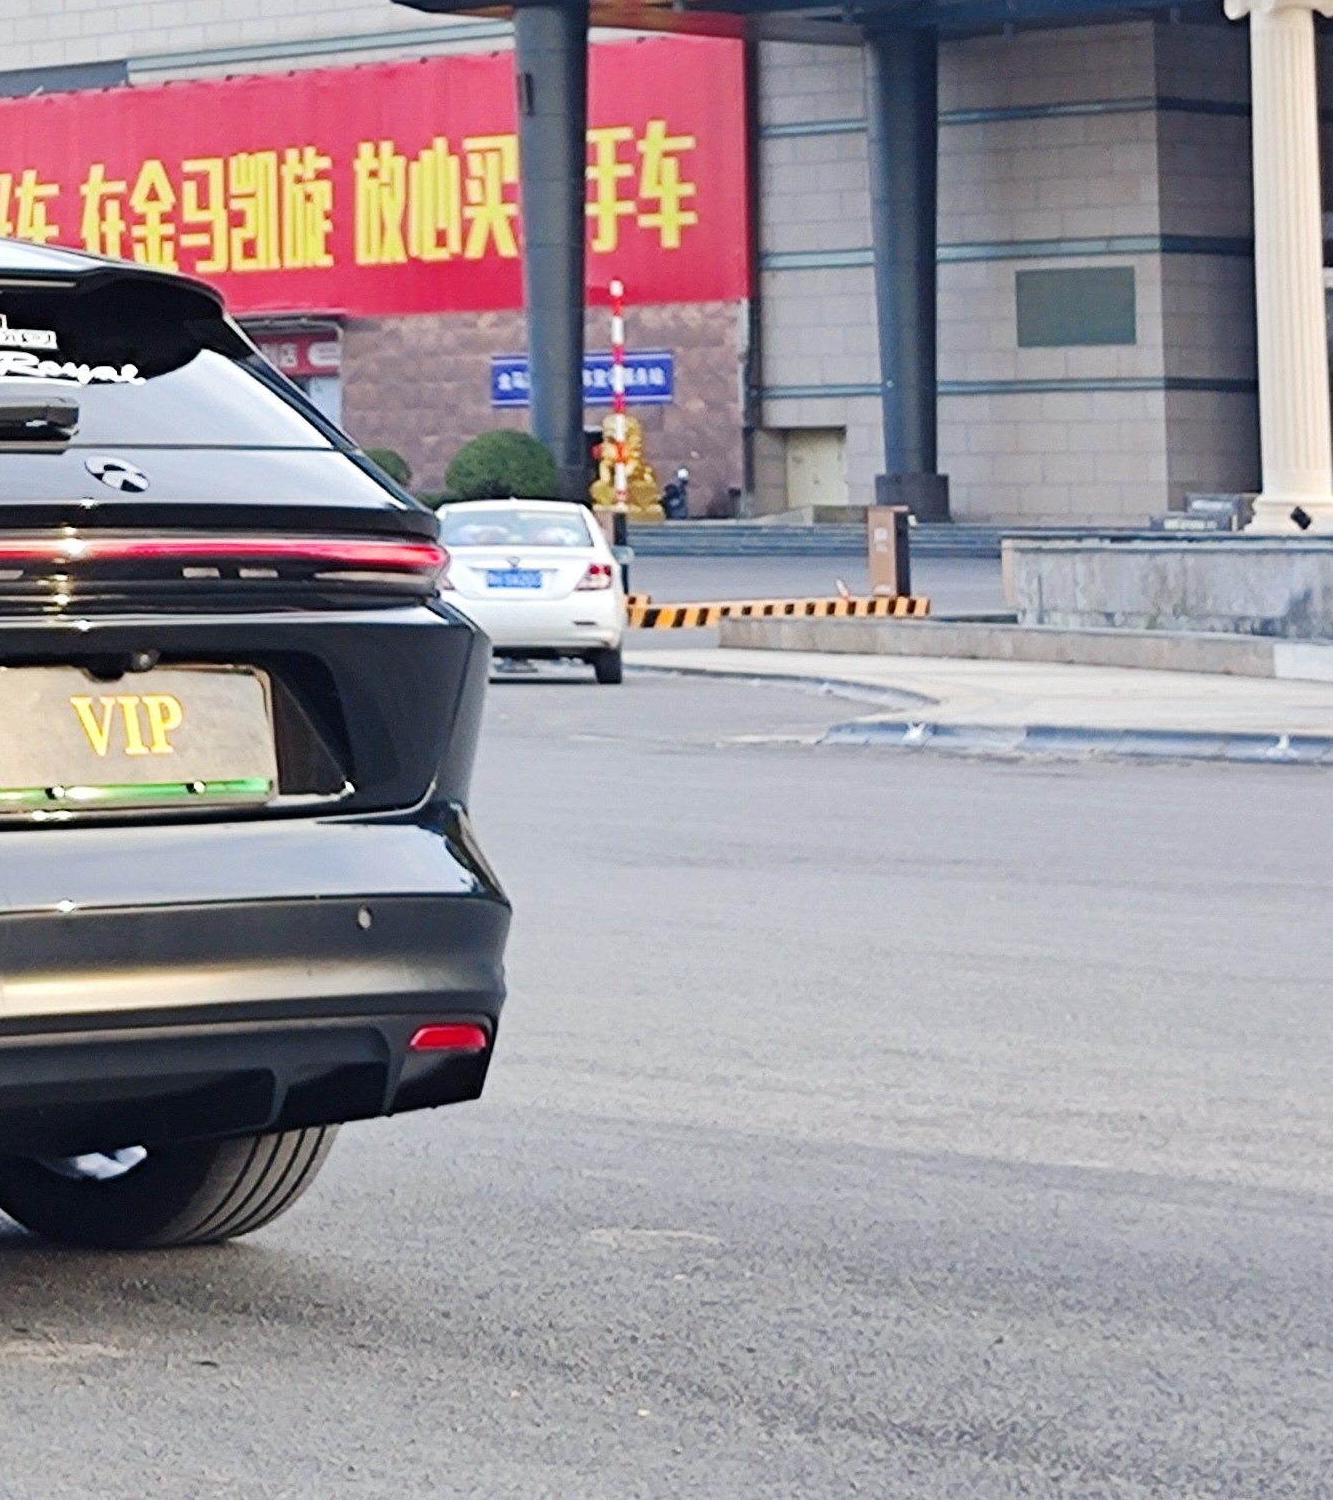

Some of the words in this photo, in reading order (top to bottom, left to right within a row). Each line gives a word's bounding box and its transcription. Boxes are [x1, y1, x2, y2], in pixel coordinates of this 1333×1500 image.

[80, 146, 334, 273] 在金马凯旋
[353, 120, 699, 266] 放心买手车
[70, 693, 184, 757] VIP
